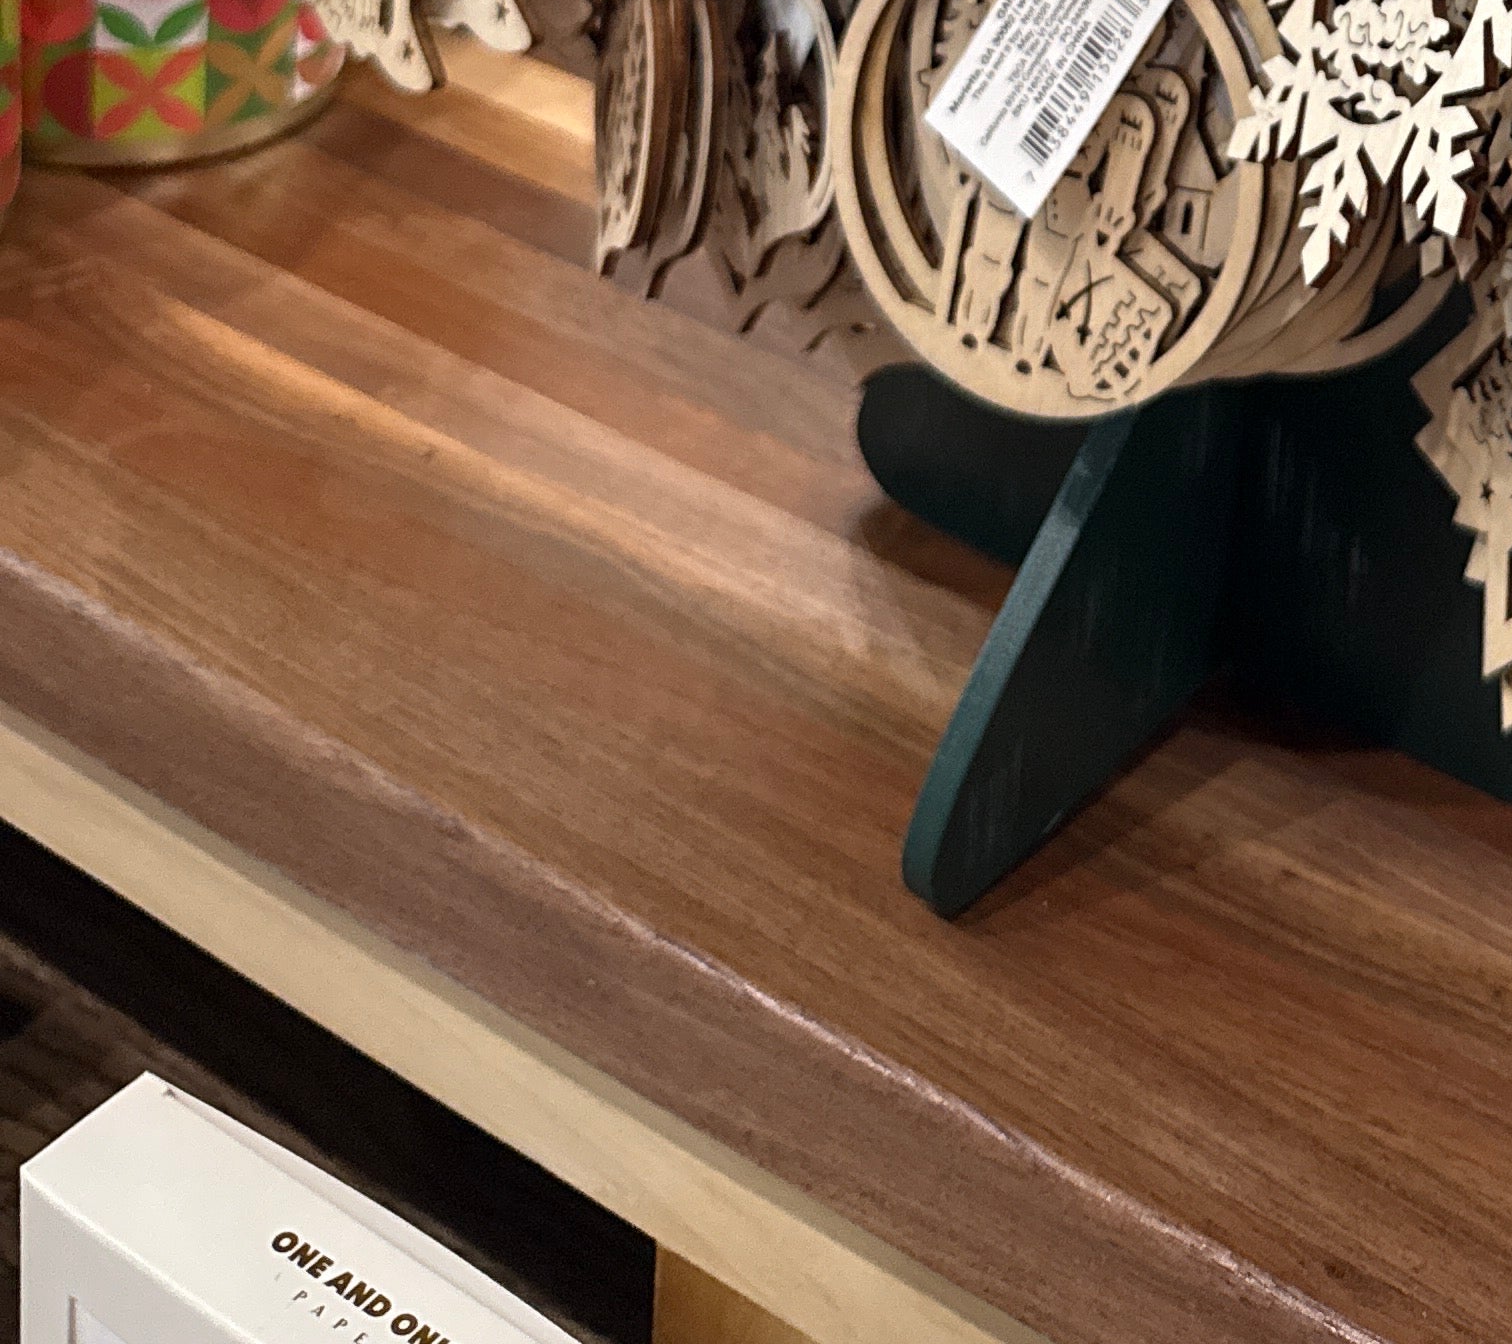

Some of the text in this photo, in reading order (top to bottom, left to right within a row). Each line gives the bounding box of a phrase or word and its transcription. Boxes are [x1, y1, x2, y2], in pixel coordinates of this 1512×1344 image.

[977, 46, 995, 66] GA
[1031, 18, 1094, 105] MADE IN CHINA
[1086, 23, 1136, 85] 15028
[272, 1231, 334, 1279] ONE
[325, 1271, 392, 1318] AND
